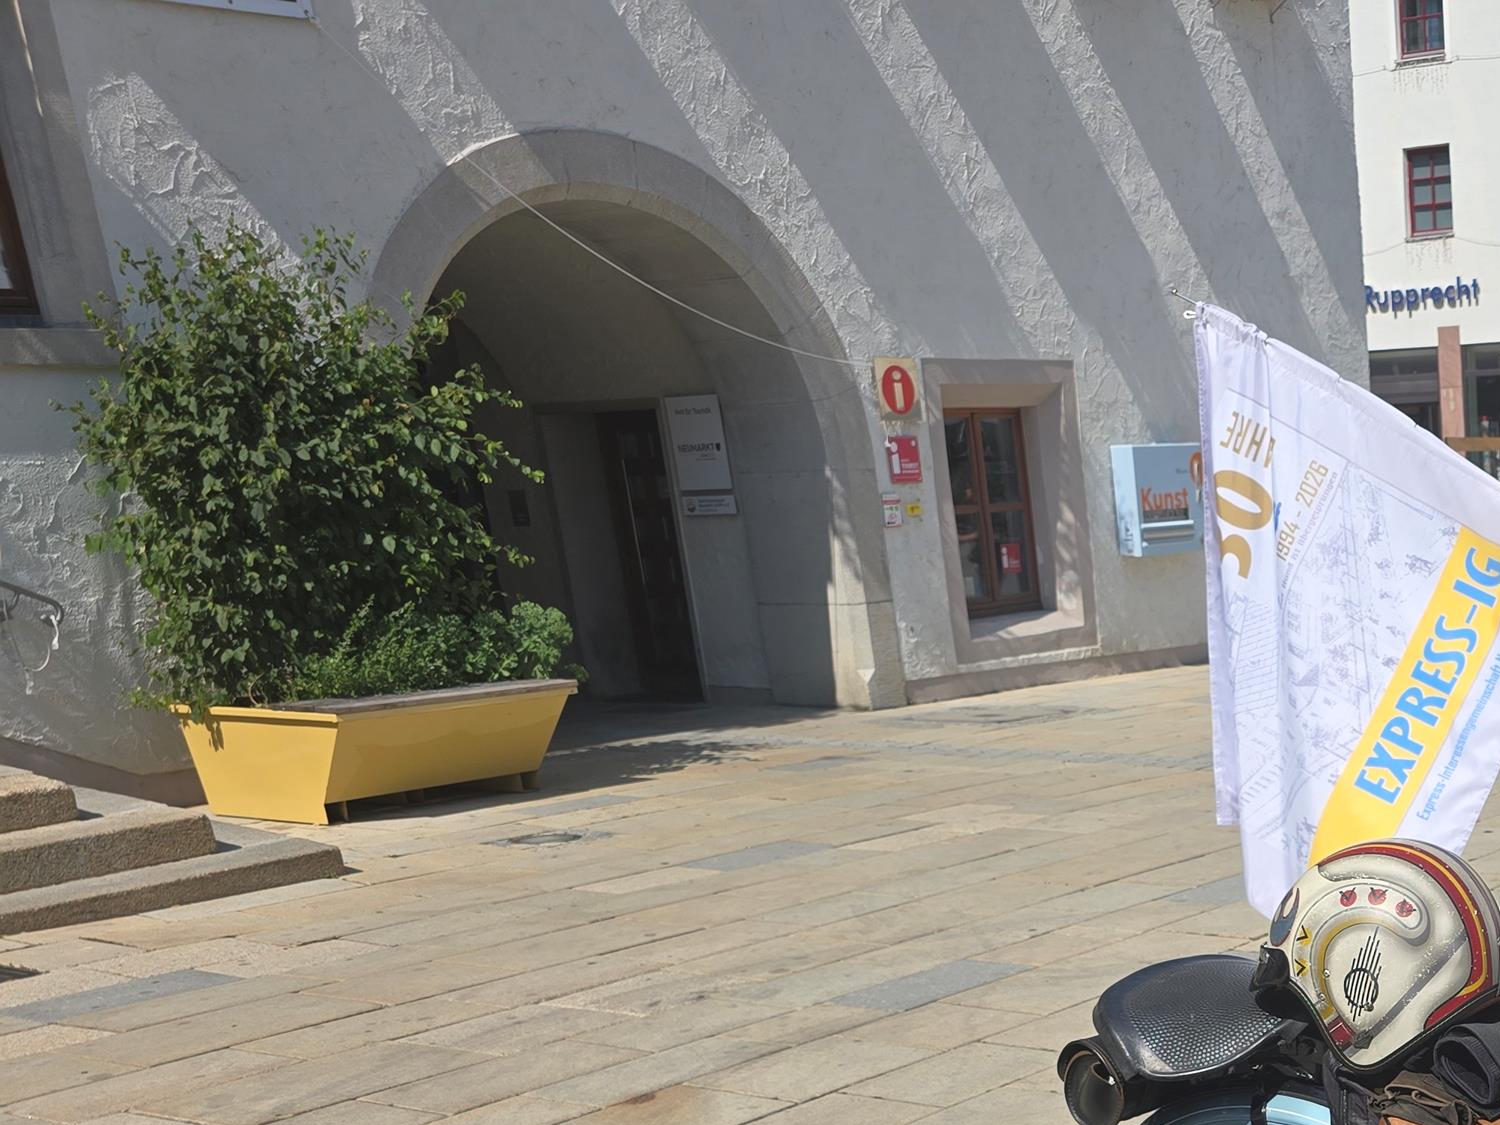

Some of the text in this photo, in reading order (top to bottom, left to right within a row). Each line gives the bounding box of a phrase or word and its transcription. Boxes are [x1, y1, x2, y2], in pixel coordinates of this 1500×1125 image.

[1365, 276, 1480, 312] Rupprecht
[1140, 487, 1189, 511] Kunst
[1295, 460, 1329, 509] 2026
